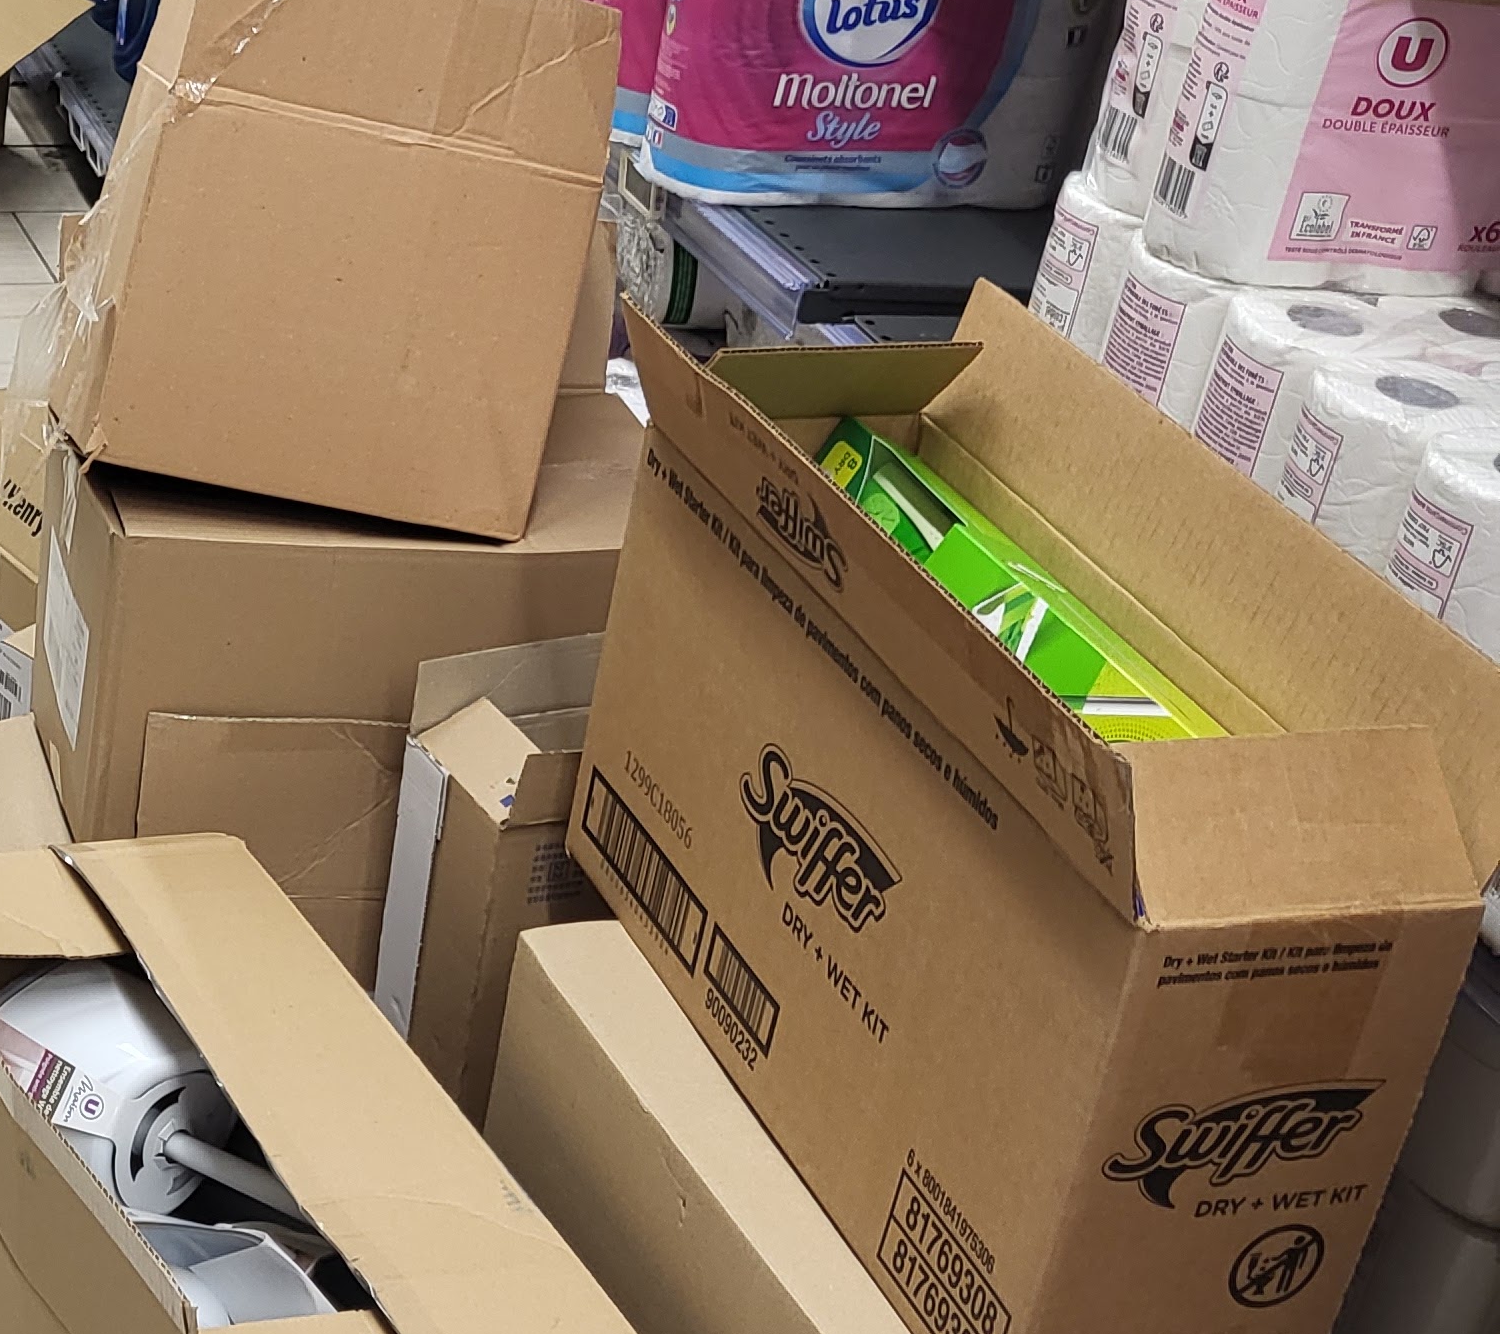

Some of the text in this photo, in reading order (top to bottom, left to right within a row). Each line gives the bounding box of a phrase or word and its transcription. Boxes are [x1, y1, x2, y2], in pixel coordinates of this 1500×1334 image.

[773, 72, 937, 110] Moltonel
[1351, 96, 1436, 122] DOUX
[807, 110, 882, 148] Style
[1322, 116, 1450, 138] DOUBLE ÉPAISSEUR
[1350, 220, 1404, 236] TRANSFORMÉ
[1362, 231, 1396, 245] FRANCE
[912, 730, 943, 773] secos
[740, 743, 888, 933] Swiffer
[782, 902, 814, 953] DRY
[825, 954, 863, 1012] WET
[860, 1004, 890, 1045] KIT
[704, 987, 760, 1072] 90090232
[1102, 1087, 1370, 1189] Swiffer
[906, 1148, 916, 1167] 6
[1194, 1183, 1370, 1220] DRY + WET KIT
